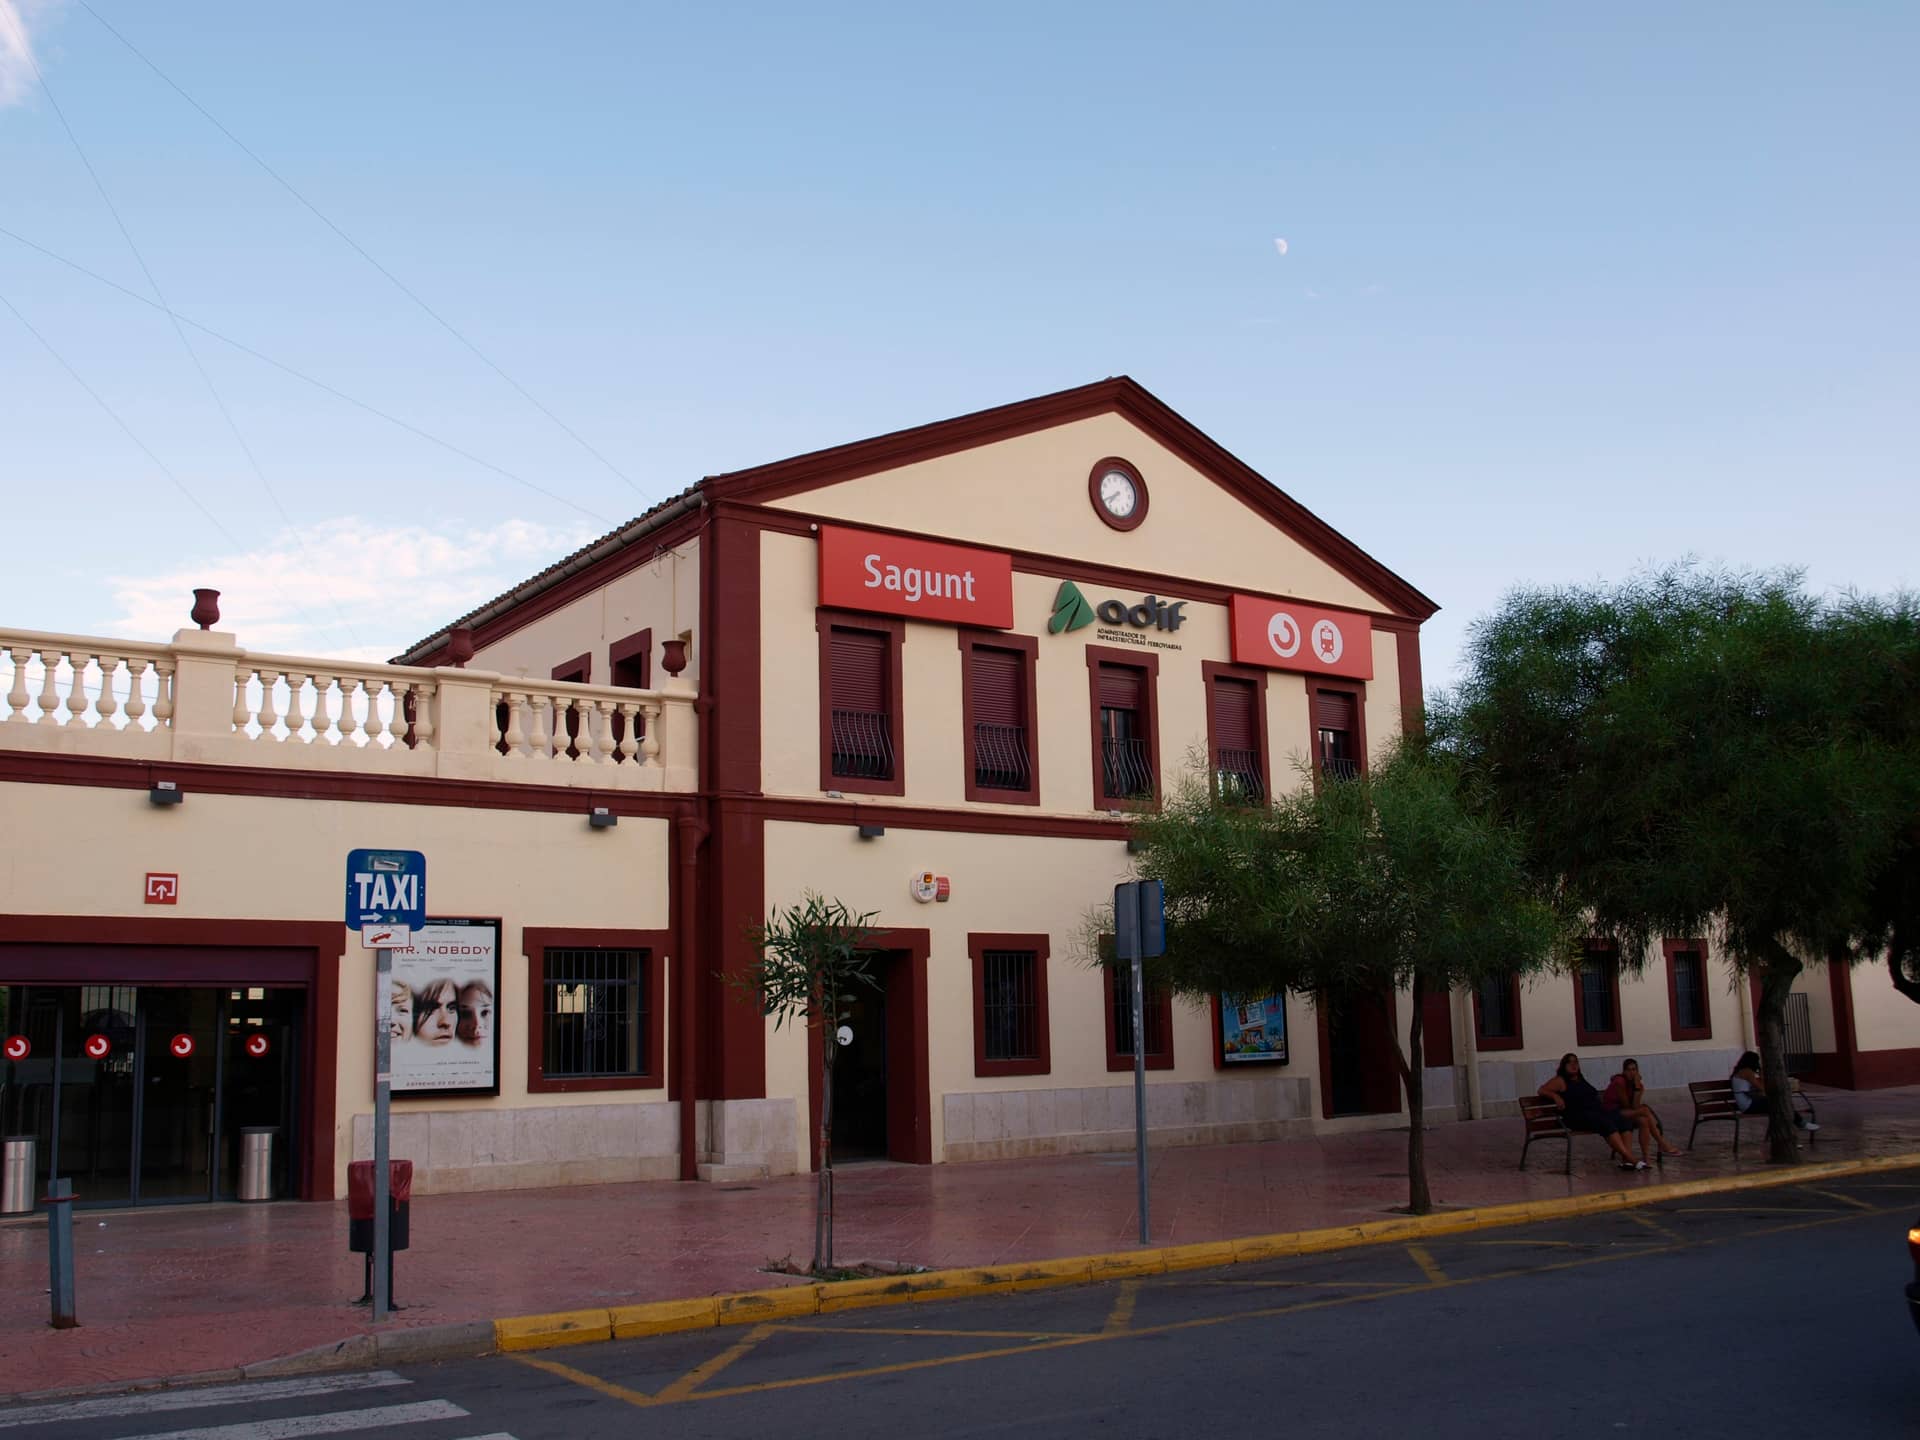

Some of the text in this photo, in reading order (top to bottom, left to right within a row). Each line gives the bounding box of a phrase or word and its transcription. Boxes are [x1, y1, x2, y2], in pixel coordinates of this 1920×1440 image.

[864, 554, 976, 602] Sagunt
[1097, 595, 1188, 632] adif
[1097, 628, 1139, 639] ADMINISTRADOR
[1097, 633, 1182, 651] INFRAESTRUCTURAS FERROVIARIAS
[355, 873, 418, 911] TAXI
[392, 946, 492, 956] MR. NOBODY
